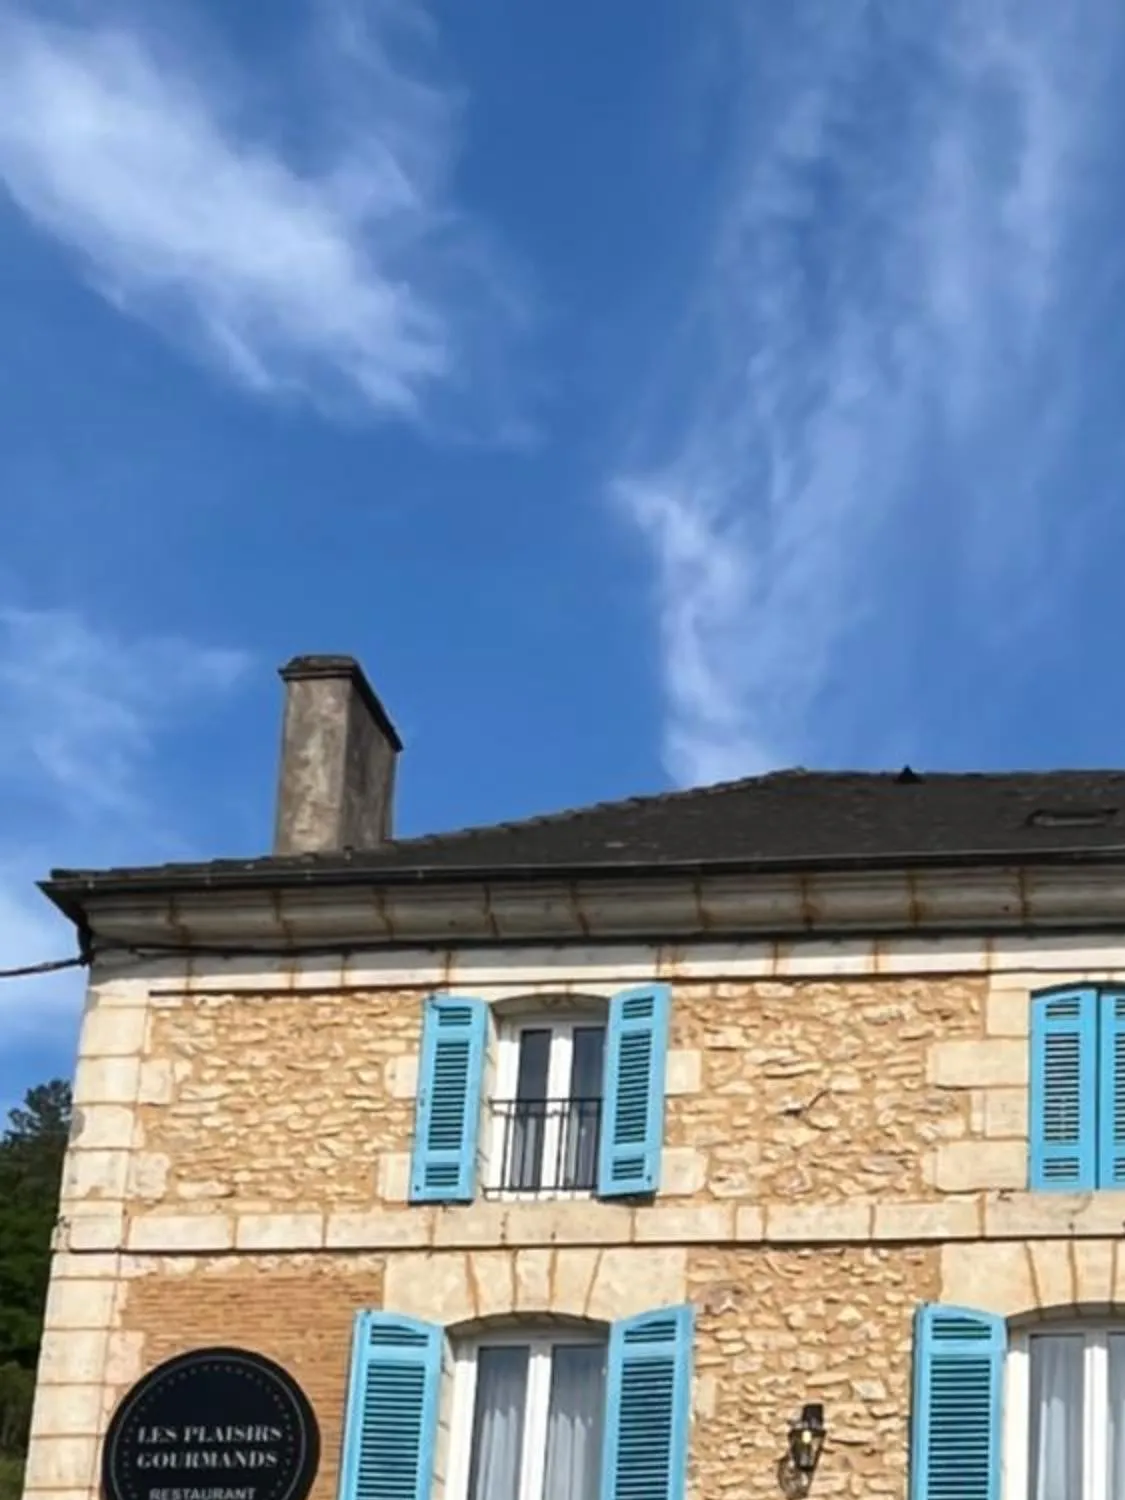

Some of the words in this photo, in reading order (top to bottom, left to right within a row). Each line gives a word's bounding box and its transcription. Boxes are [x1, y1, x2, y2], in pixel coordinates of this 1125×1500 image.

[137, 1425, 177, 1444] LES
[183, 1424, 283, 1443] PLAISIRS
[136, 1451, 278, 1469] GOURMANDS
